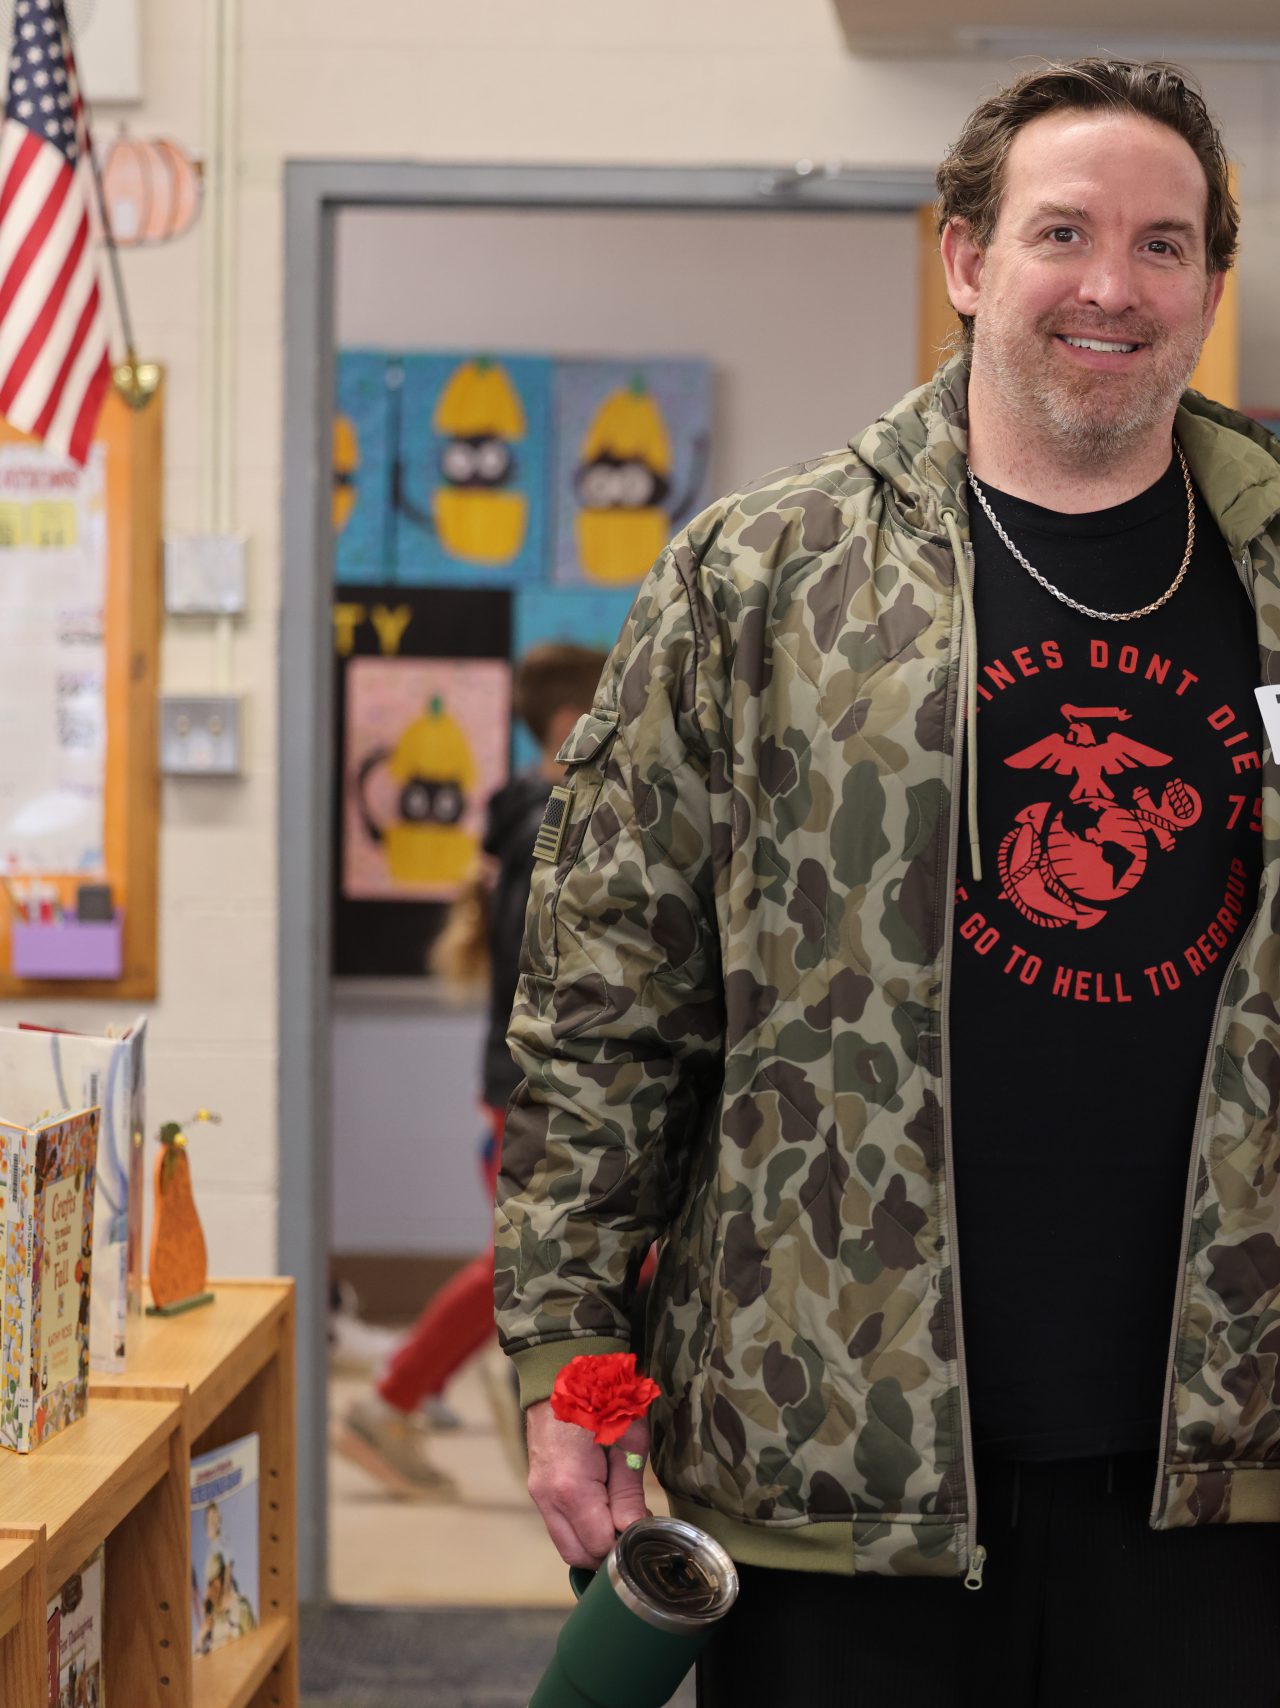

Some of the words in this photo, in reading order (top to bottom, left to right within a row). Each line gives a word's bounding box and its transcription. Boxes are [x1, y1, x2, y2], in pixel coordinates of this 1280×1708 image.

[969, 640, 1063, 713] INES
[1090, 639, 1199, 697] DONT
[1206, 704, 1262, 775] DIE
[959, 912, 1000, 956] GO
[1003, 945, 1043, 986] TO
[1052, 966, 1132, 1003] HELL
[1144, 960, 1181, 996] TO
[1183, 857, 1248, 976] REGROUP
[51, 1190, 76, 1224] Crafts
[53, 1259, 70, 1292] Fall
